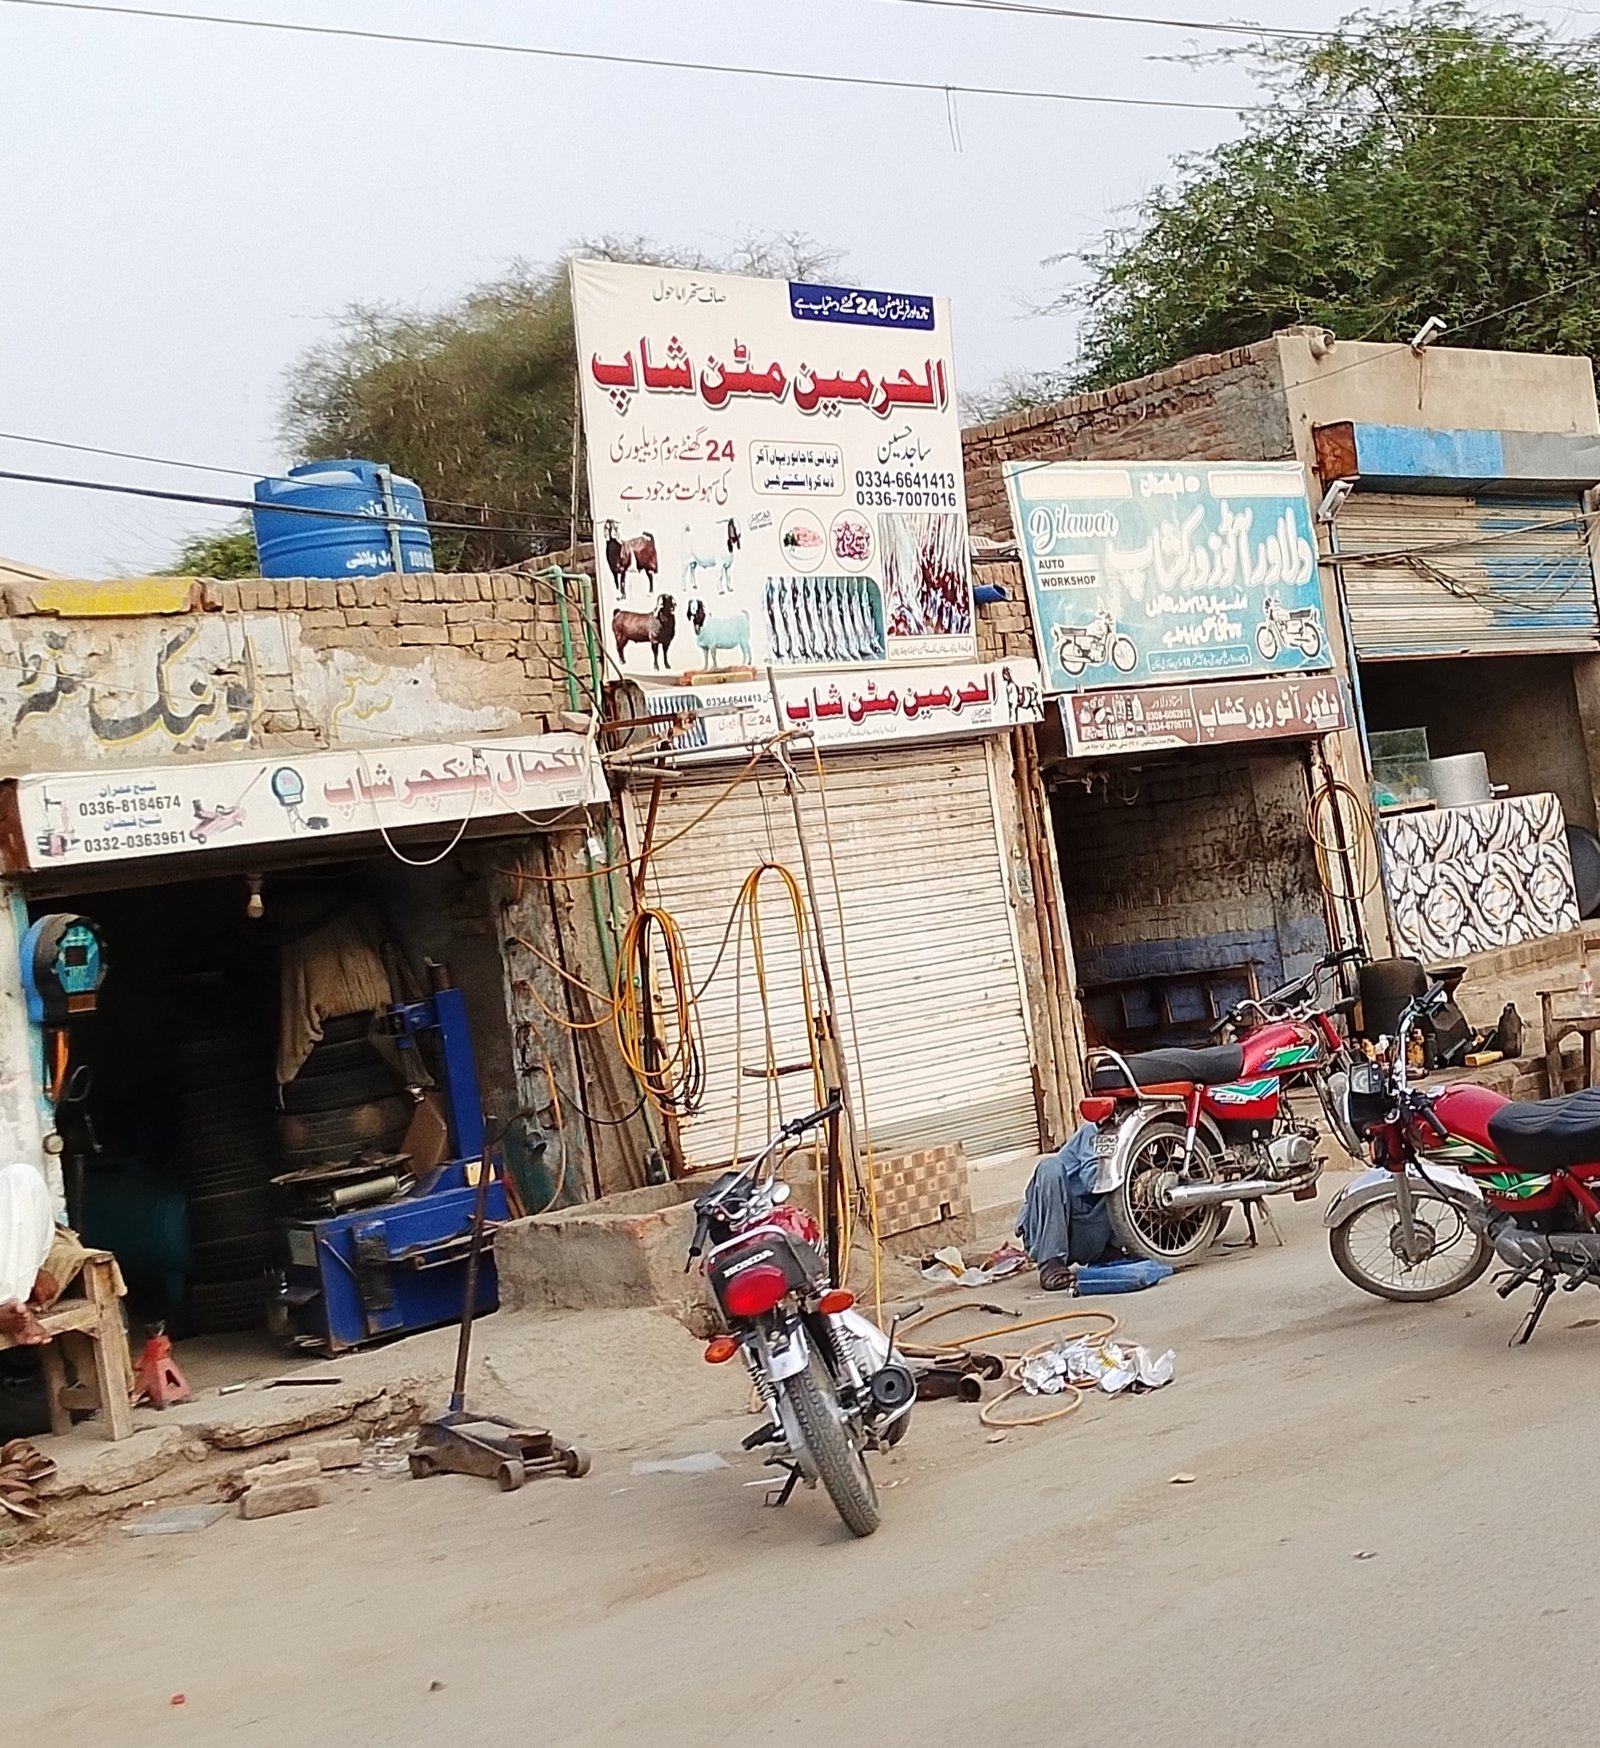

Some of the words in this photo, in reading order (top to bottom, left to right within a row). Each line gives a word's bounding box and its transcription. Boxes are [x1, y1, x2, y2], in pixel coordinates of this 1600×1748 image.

[698, 286, 727, 303] صاف
[794, 298, 811, 316] ہے
[857, 296, 879, 316] 24
[591, 335, 694, 415] شاپ
[699, 337, 788, 408] مٹن
[793, 358, 949, 417] الحرمین
[610, 424, 658, 463] ڈیلیوری
[660, 435, 679, 466] ہوم
[679, 425, 708, 461] گھنٹے
[705, 439, 735, 462] 24
[877, 425, 912, 465] حسین
[901, 437, 931, 468] ساجد
[645, 480, 681, 501] موجود
[675, 475, 720, 503] سہولت
[715, 467, 732, 506] کی
[855, 470, 955, 489] 0334-6641413
[620, 485, 645, 513] ہے
[856, 490, 957, 507] 0336-7007016
[1028, 504, 1119, 554] Dilawar
[1250, 506, 1314, 586] دلاور
[1038, 558, 1066, 571] AUTO
[1040, 574, 1097, 588] WORKSHOP
[706, 693, 762, 707] 0334-6641413
[785, 683, 844, 729] شاپ
[848, 678, 900, 723] مٹن
[902, 671, 998, 719] الحرمین
[1303, 687, 1340, 724] دلاور
[758, 714, 772, 725] 24
[400, 757, 494, 811] پنکچر
[497, 745, 587, 796] الکمال
[323, 762, 397, 818] شاپ
[79, 795, 181, 817] 0336-8184674
[84, 830, 186, 853] 0332-0363961
[722, 1249, 775, 1279] HONDA
